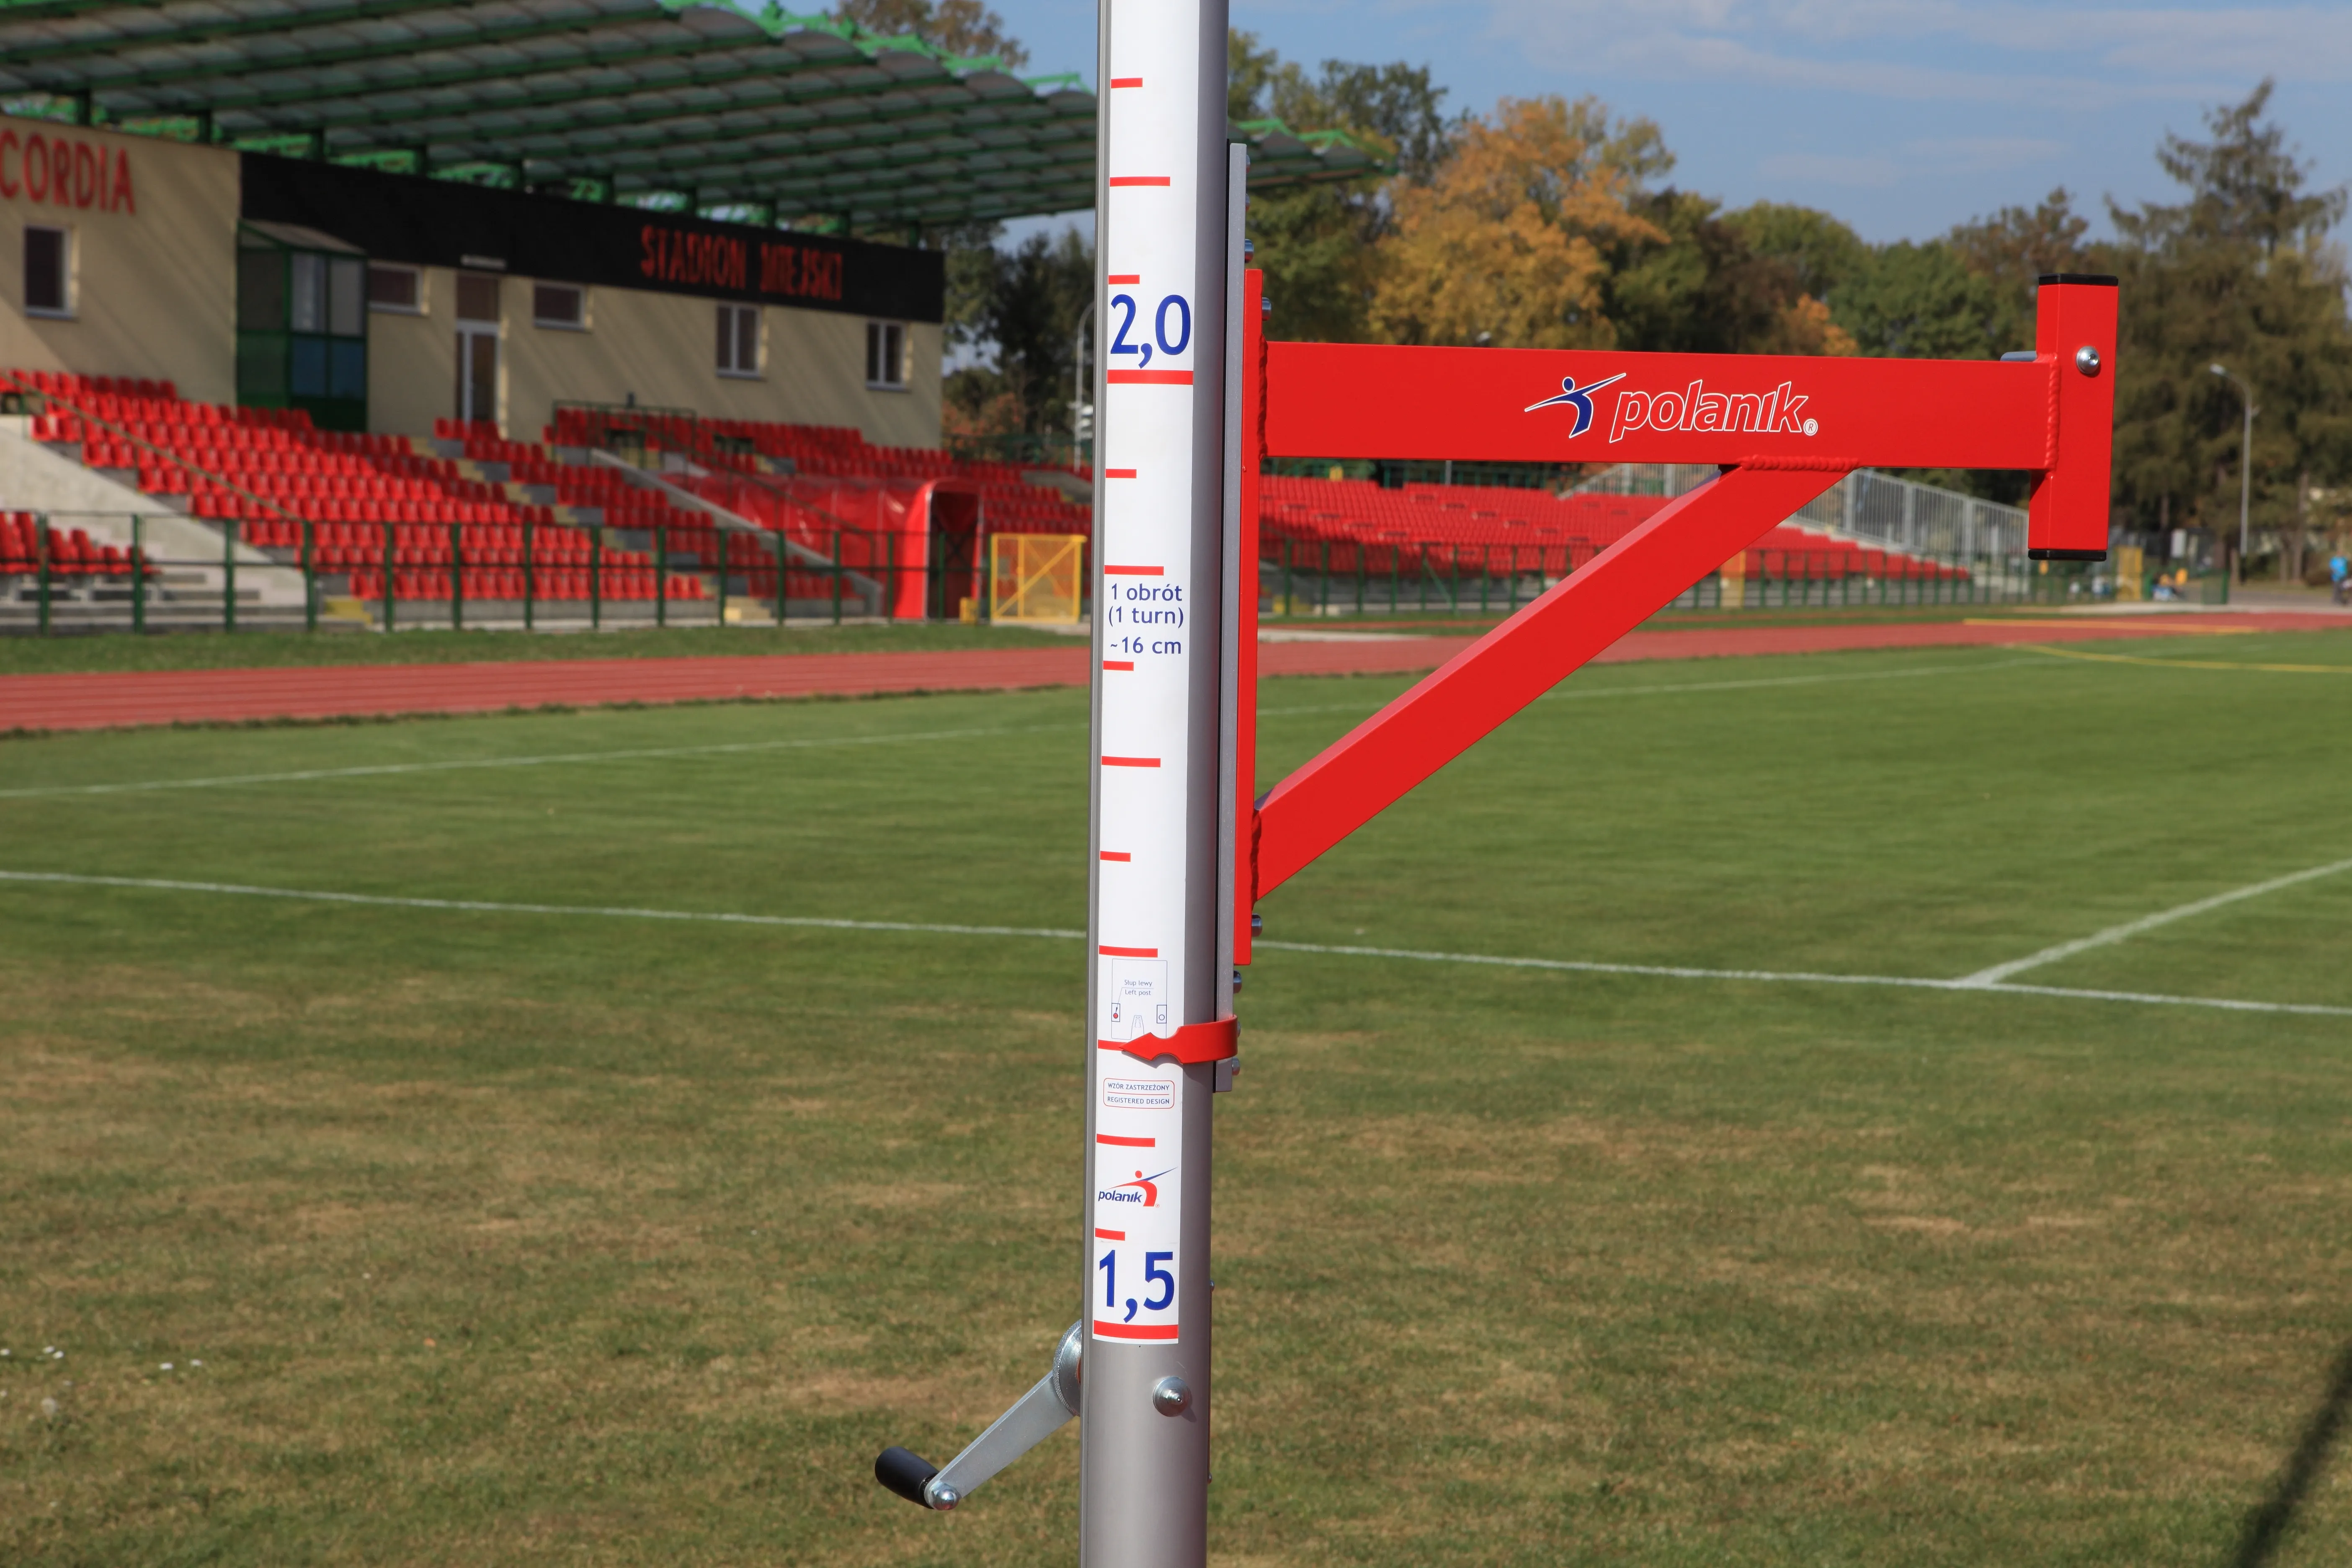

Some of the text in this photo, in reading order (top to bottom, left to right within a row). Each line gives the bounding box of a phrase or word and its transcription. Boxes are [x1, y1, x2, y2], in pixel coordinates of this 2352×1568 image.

[0, 129, 136, 215] CORDIA
[641, 225, 746, 289] STADION
[1110, 294, 1191, 369] 2,0
[1609, 379, 1809, 444] polanik
[1109, 606, 1184, 628] (1 turn)
[1112, 583, 1182, 601] 1 obrót
[1152, 641, 1181, 654] cm
[1098, 1190, 1143, 1203] polanik
[1099, 1249, 1175, 1323] 1,5
